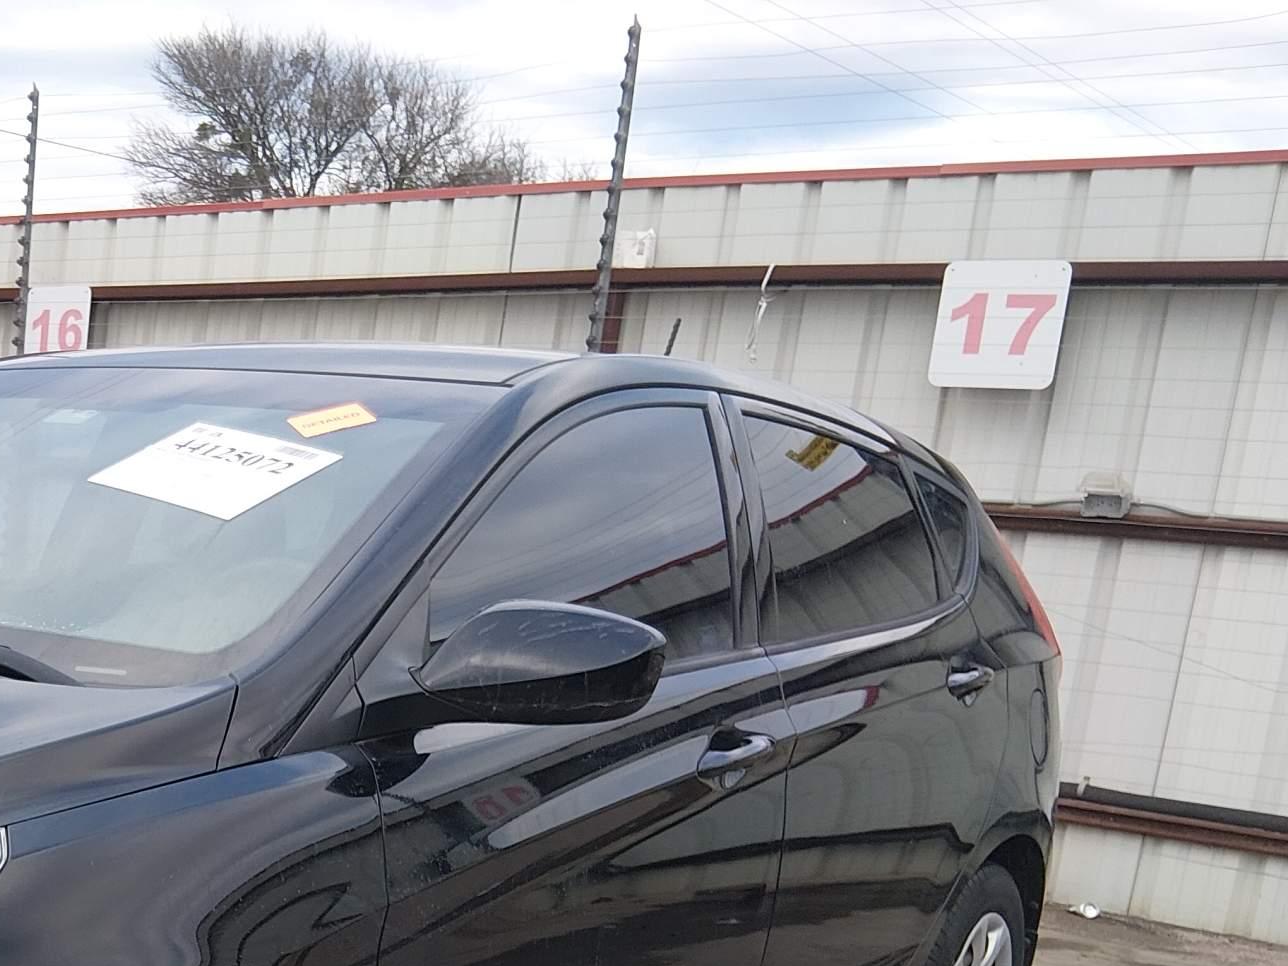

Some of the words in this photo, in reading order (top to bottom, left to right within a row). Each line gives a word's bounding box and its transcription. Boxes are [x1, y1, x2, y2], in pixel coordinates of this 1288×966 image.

[31, 308, 83, 353] 16
[949, 292, 1059, 356] 17
[174, 438, 295, 475] 44125072
